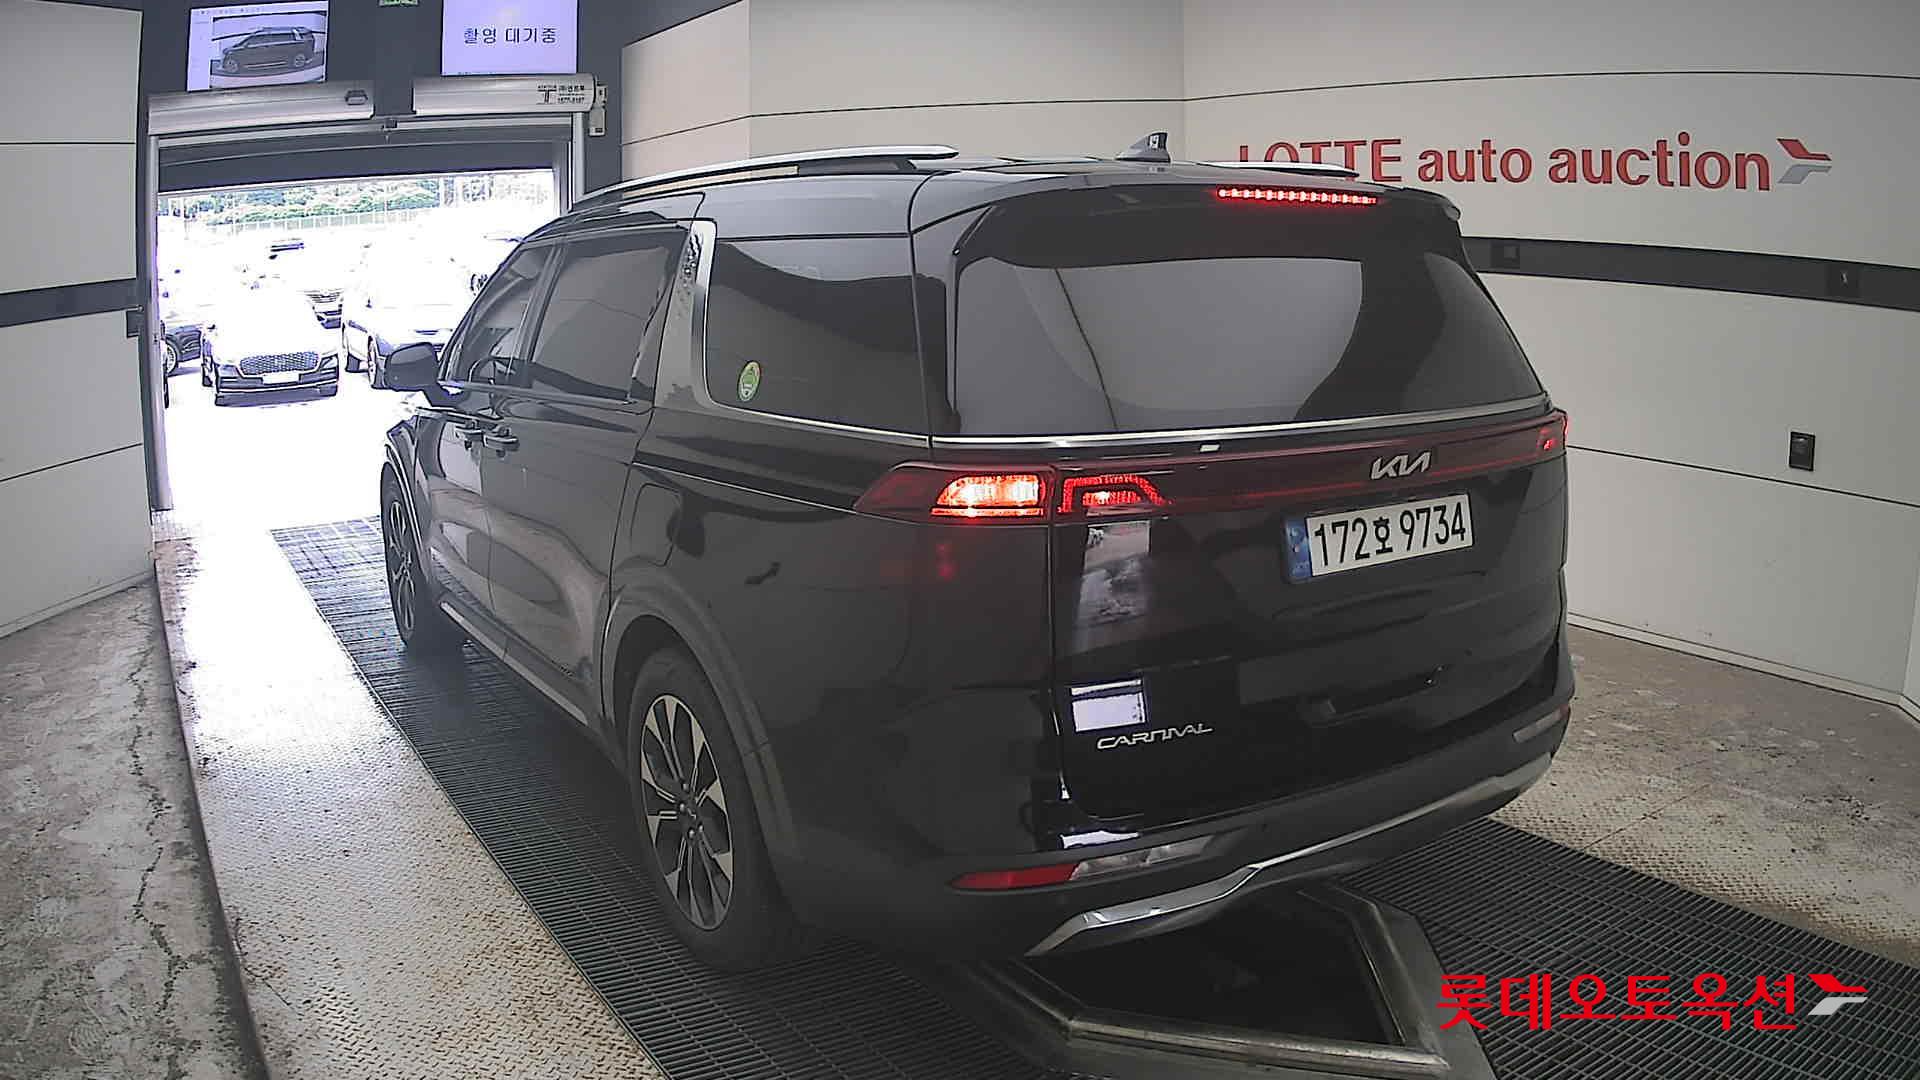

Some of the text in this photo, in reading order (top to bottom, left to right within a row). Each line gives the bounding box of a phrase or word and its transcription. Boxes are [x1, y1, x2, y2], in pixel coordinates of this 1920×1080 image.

[464, 27, 558, 44] 촬영 대기중
[1418, 139, 1533, 183] auto
[1549, 131, 1771, 191] auction
[1314, 502, 1466, 567] 172호 9734
[1097, 723, 1213, 749] CARNIVAL
